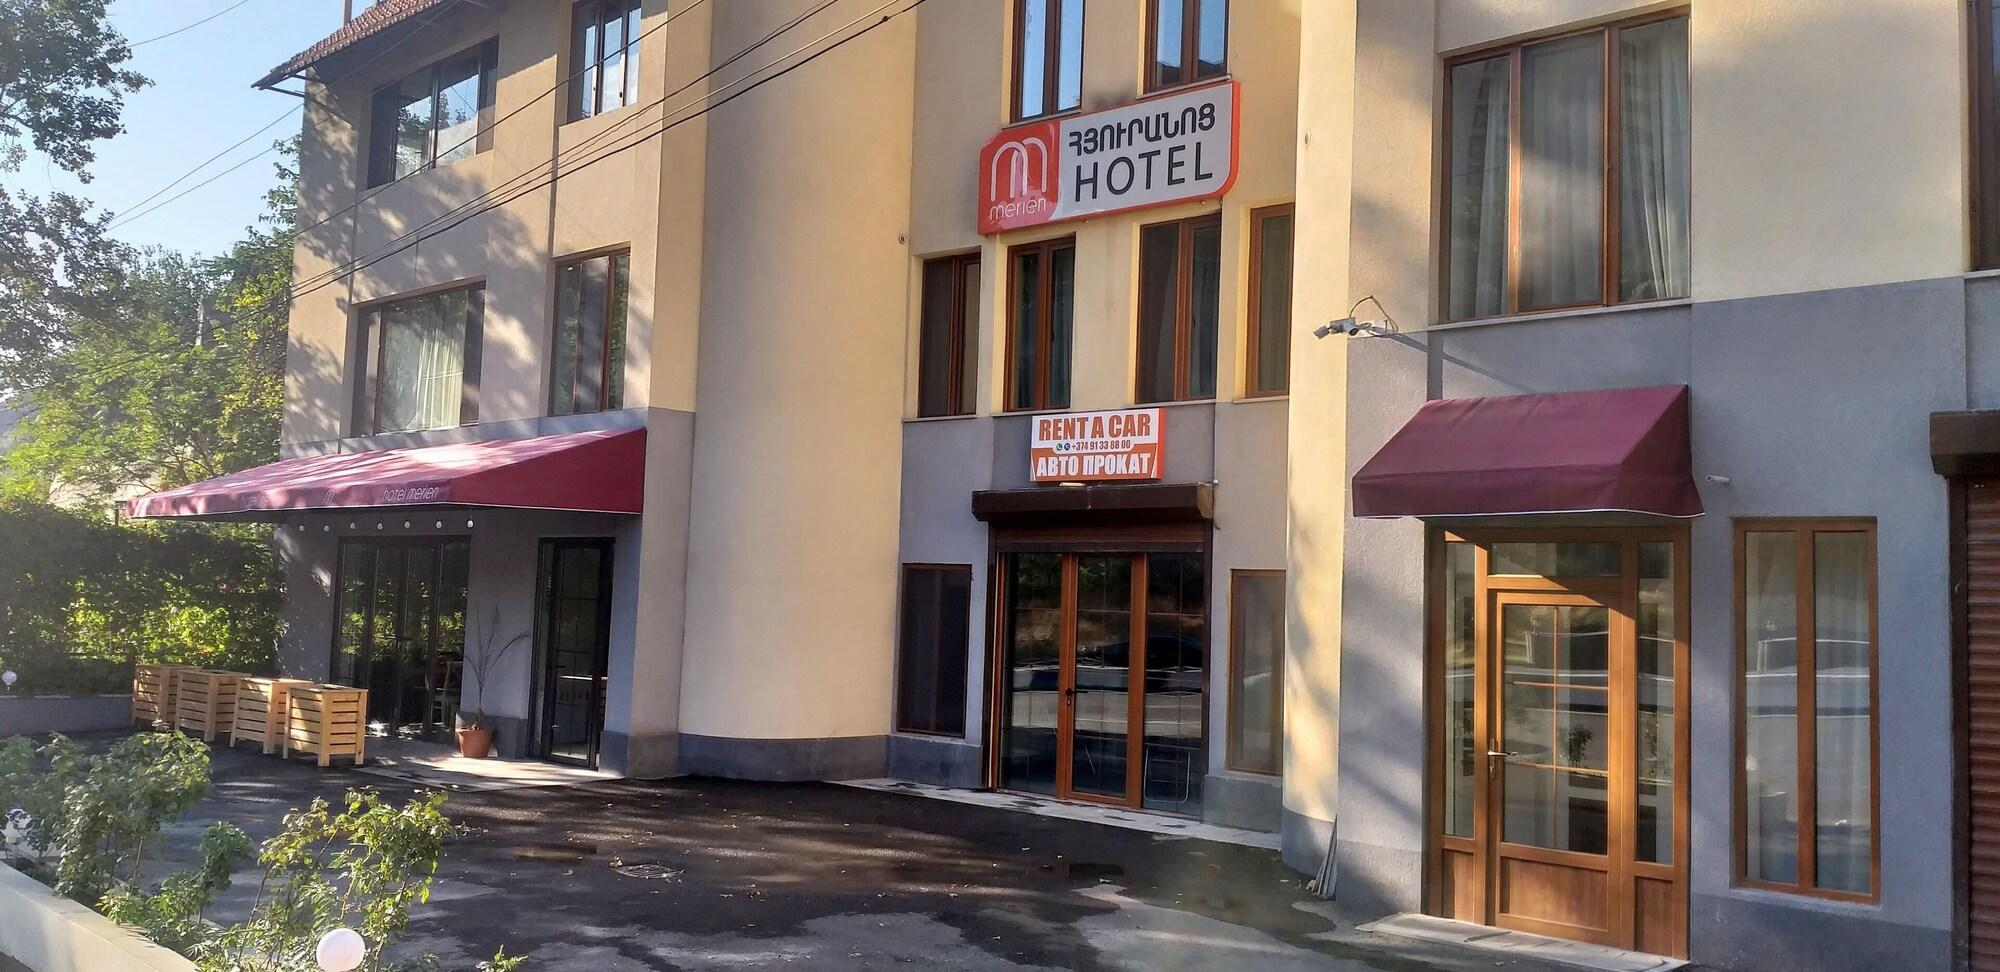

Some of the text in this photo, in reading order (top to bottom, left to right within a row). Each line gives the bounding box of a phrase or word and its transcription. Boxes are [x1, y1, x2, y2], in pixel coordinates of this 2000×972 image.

[1068, 102, 1216, 157] ՀՅՈՒՐԱՆՈՑ
[1074, 141, 1213, 202] HOTEL
[1039, 413, 1151, 441] RENT A CAR
[1089, 441, 1098, 450] 91
[1036, 452, 1151, 477] АВТО ПРОКАТ
[381, 486, 408, 502] hotel
